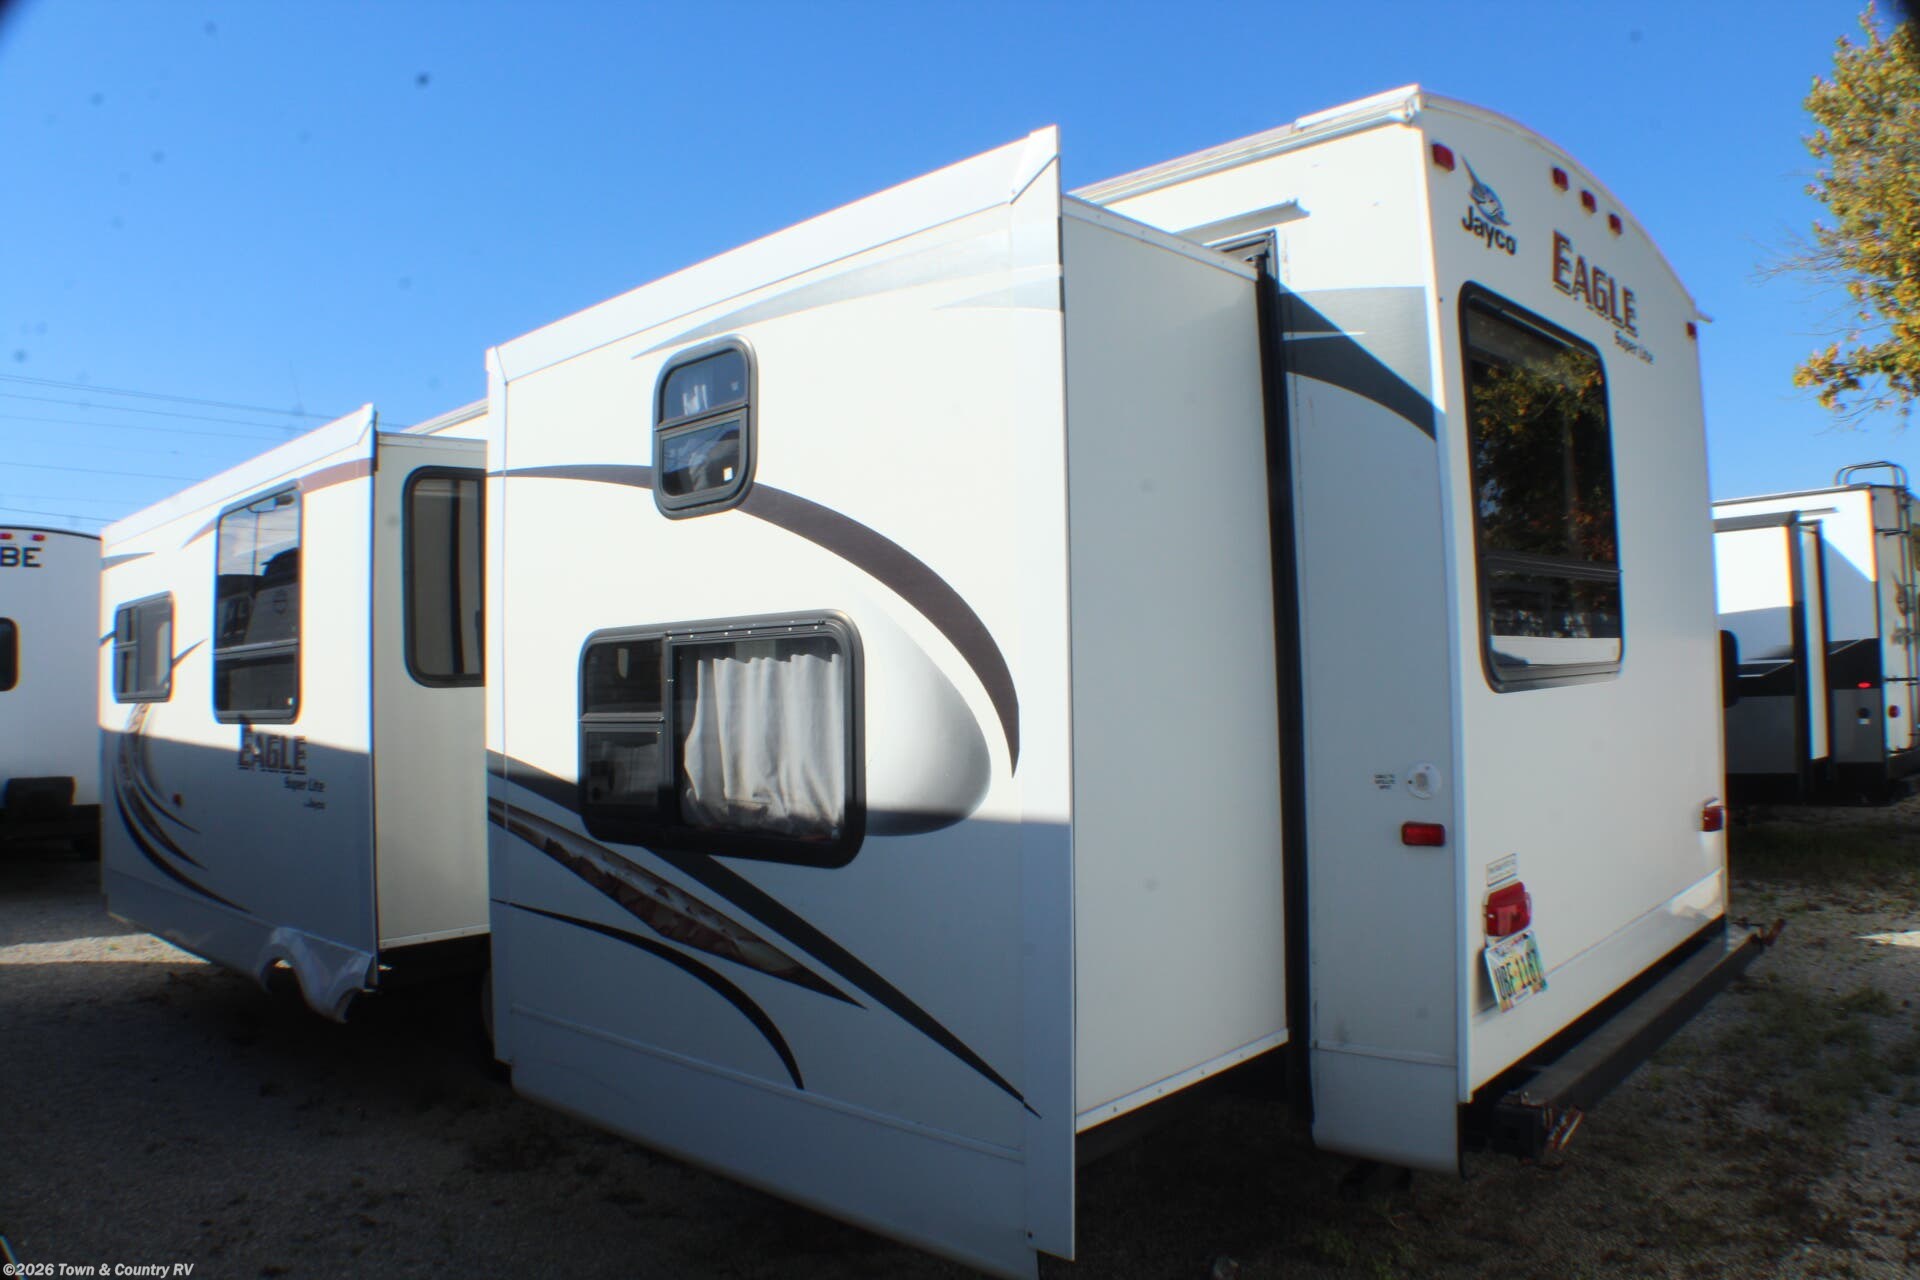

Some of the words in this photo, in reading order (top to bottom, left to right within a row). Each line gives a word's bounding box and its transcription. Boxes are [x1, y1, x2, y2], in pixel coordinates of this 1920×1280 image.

[1462, 206, 1518, 256] Jayco
[1552, 229, 1638, 338] EAGLE
[0, 546, 43, 568] BE
[239, 721, 306, 775] EAGLE
